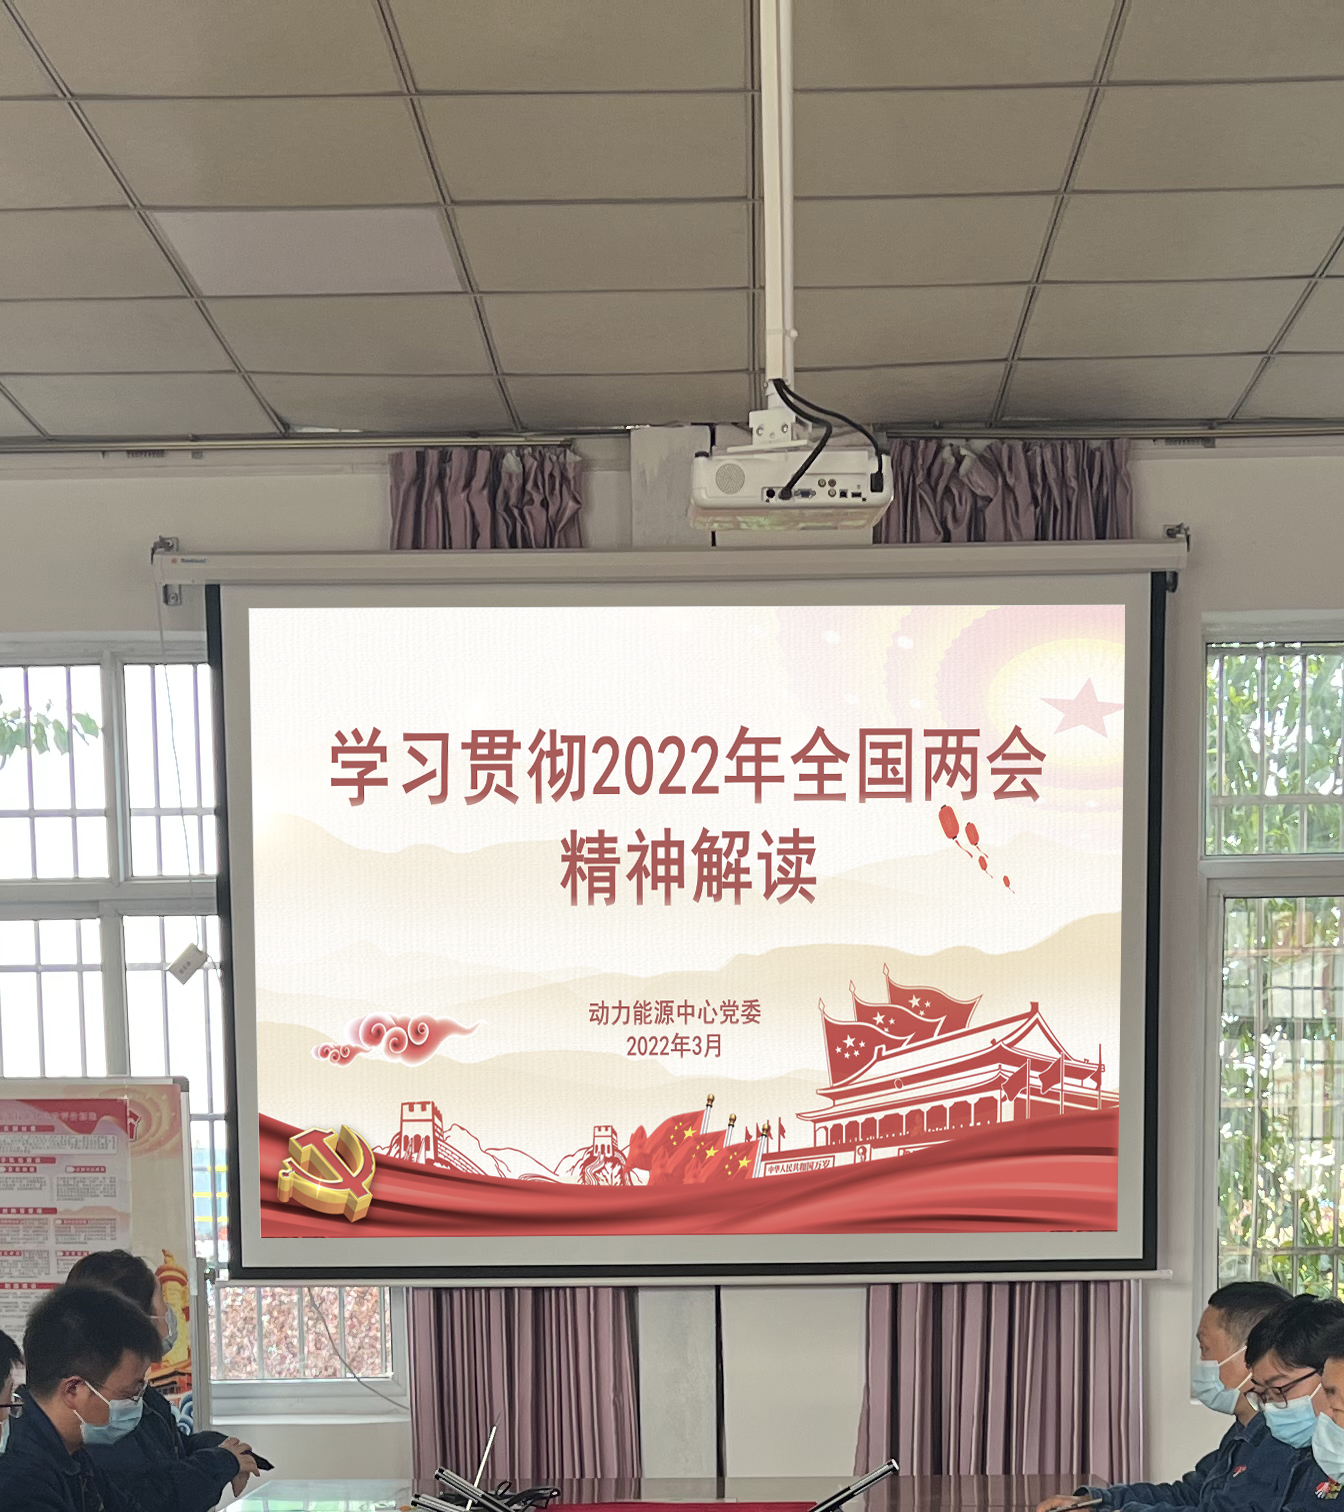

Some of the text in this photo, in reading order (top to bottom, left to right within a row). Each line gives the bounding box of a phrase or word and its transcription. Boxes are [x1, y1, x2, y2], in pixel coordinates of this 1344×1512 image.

[329, 724, 1047, 807] 学习贯彻2022年全国两会
[560, 827, 818, 907] 精神解读
[588, 998, 761, 1026] 动力能源中心党委
[626, 1032, 722, 1058] 2022年3月
[767, 1157, 831, 1174] 中华人民共和国万岁
